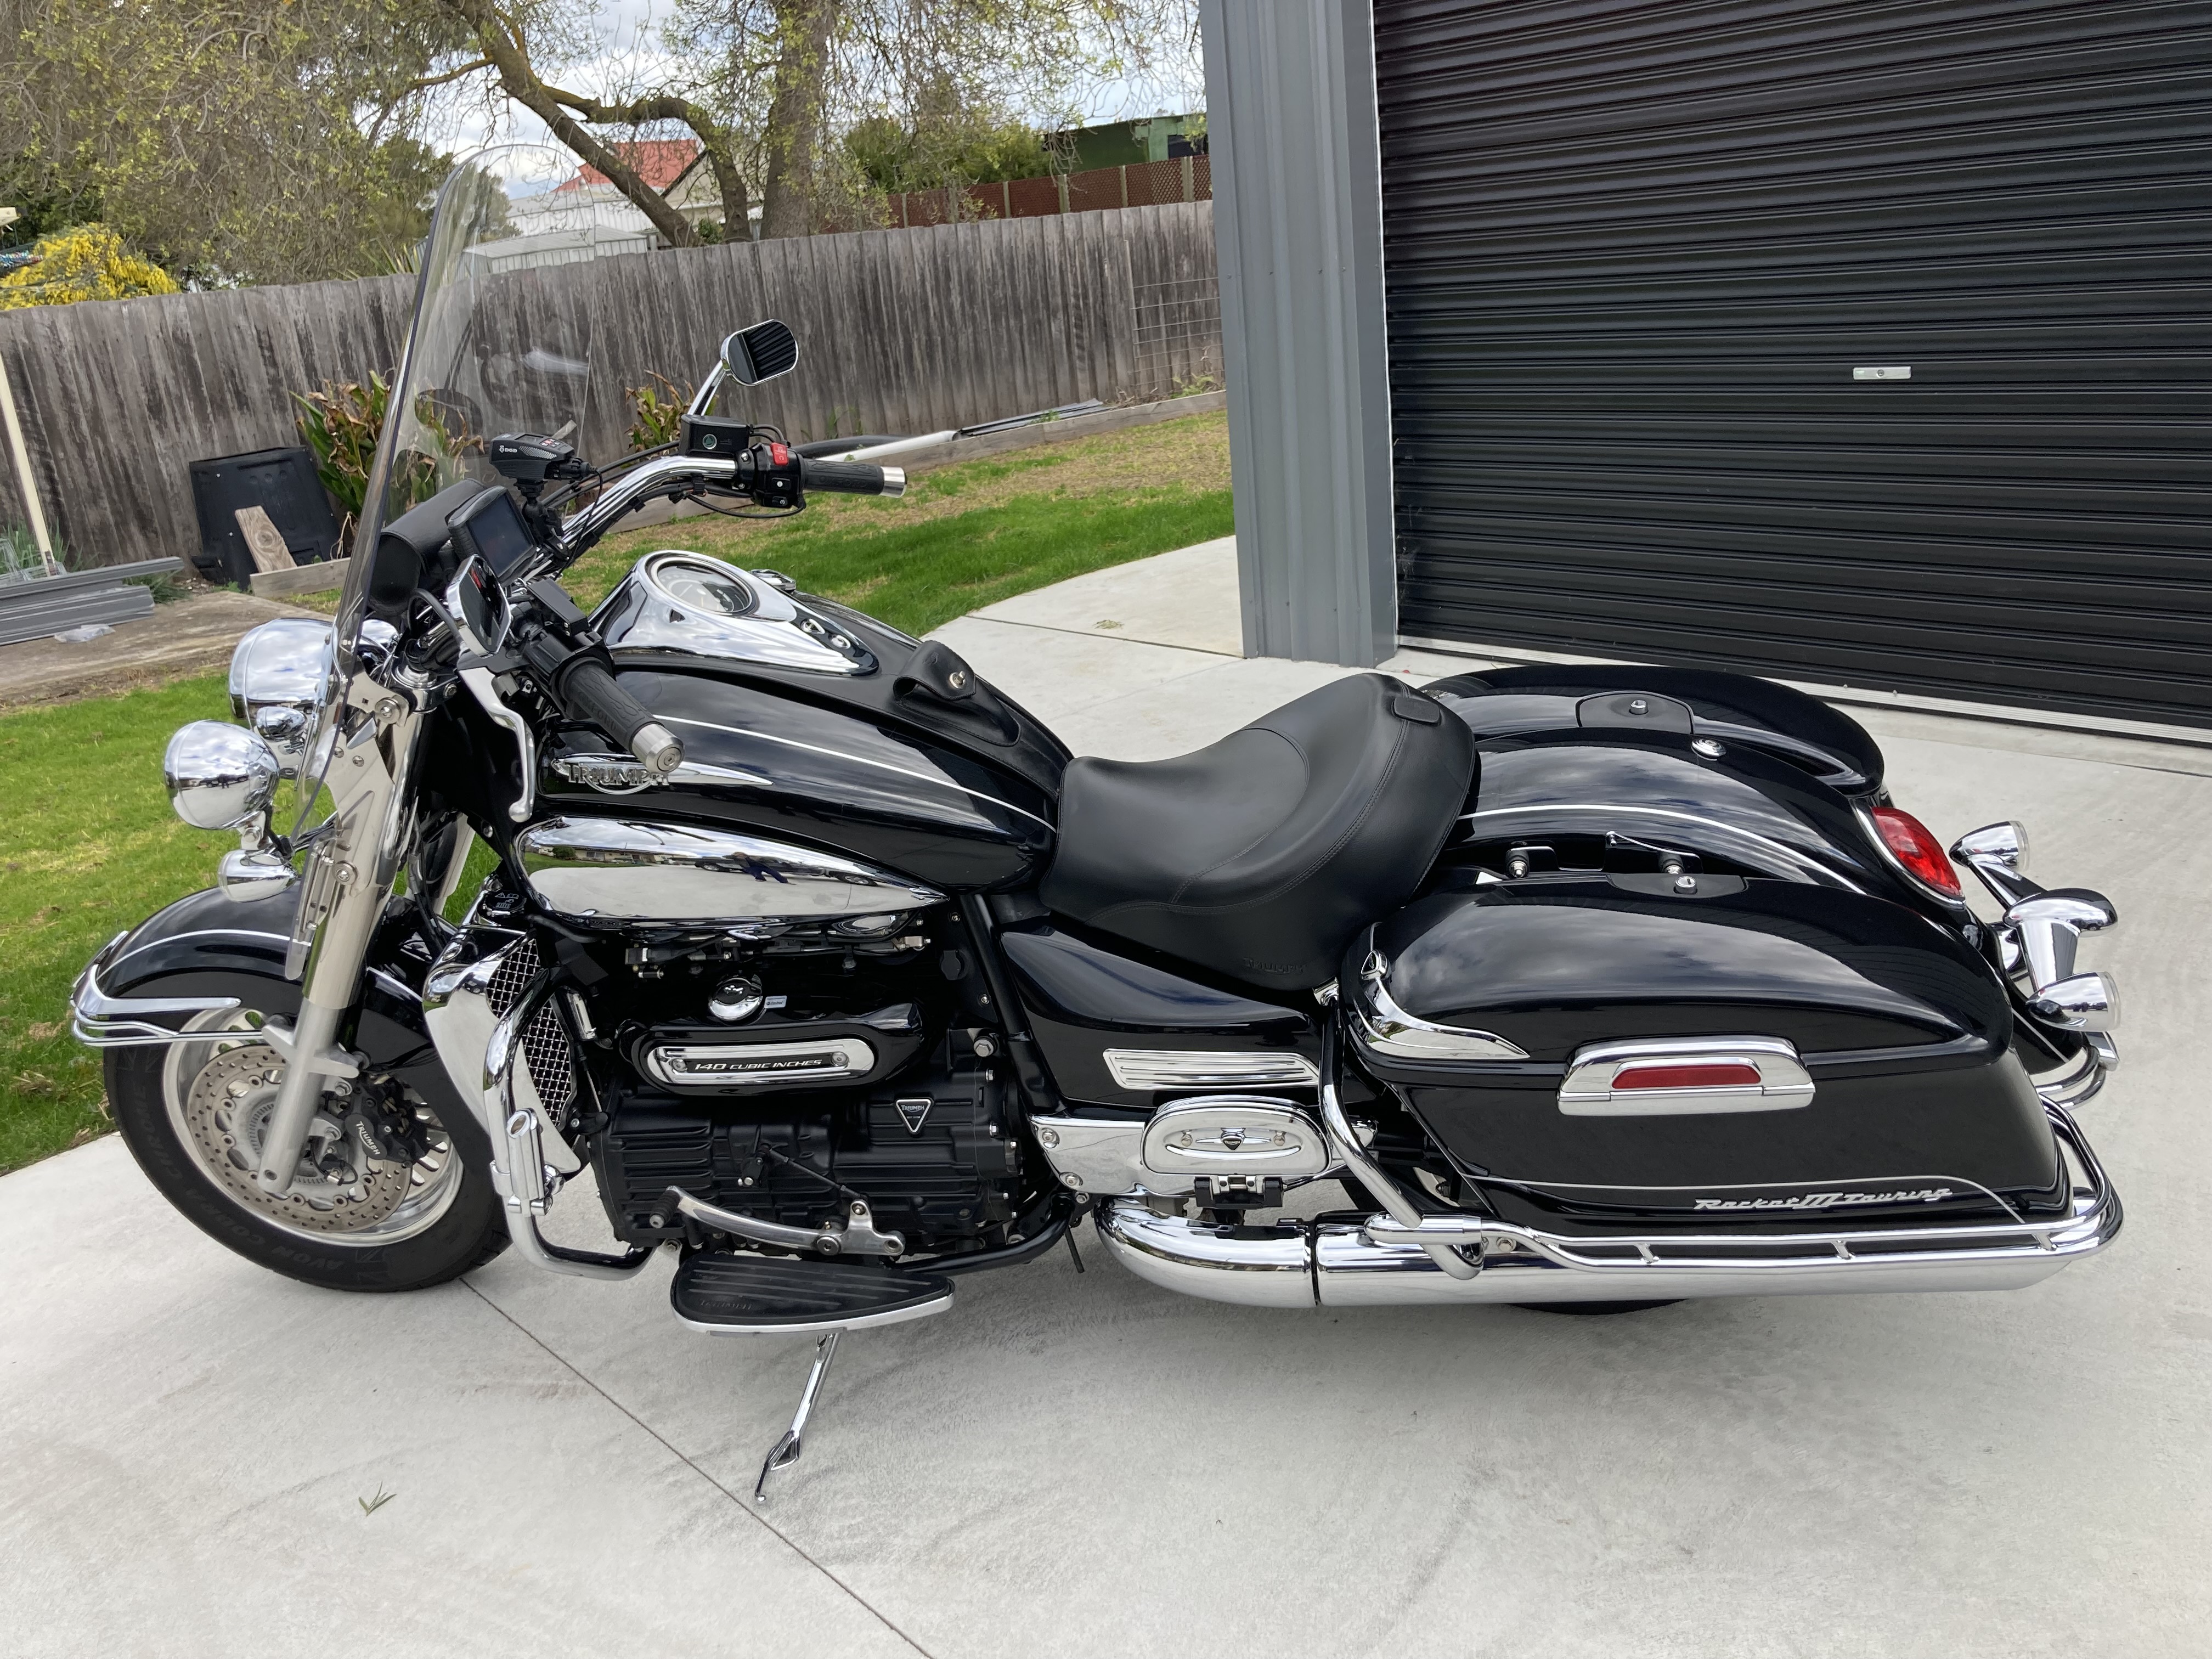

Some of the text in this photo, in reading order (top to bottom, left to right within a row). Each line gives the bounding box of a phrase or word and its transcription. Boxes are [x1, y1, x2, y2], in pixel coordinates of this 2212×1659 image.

[565, 761, 669, 793] TRIUMPH
[772, 1059, 823, 1068] INCHES
[900, 1105, 925, 1113] TRIUMPH
[356, 1120, 381, 1155] TRIUMPH
[1693, 1197, 1800, 1210] Rocket
[1839, 1188, 1953, 1205] Touring
[184, 1187, 267, 1246] COBRA
[271, 1245, 346, 1269] AVON
